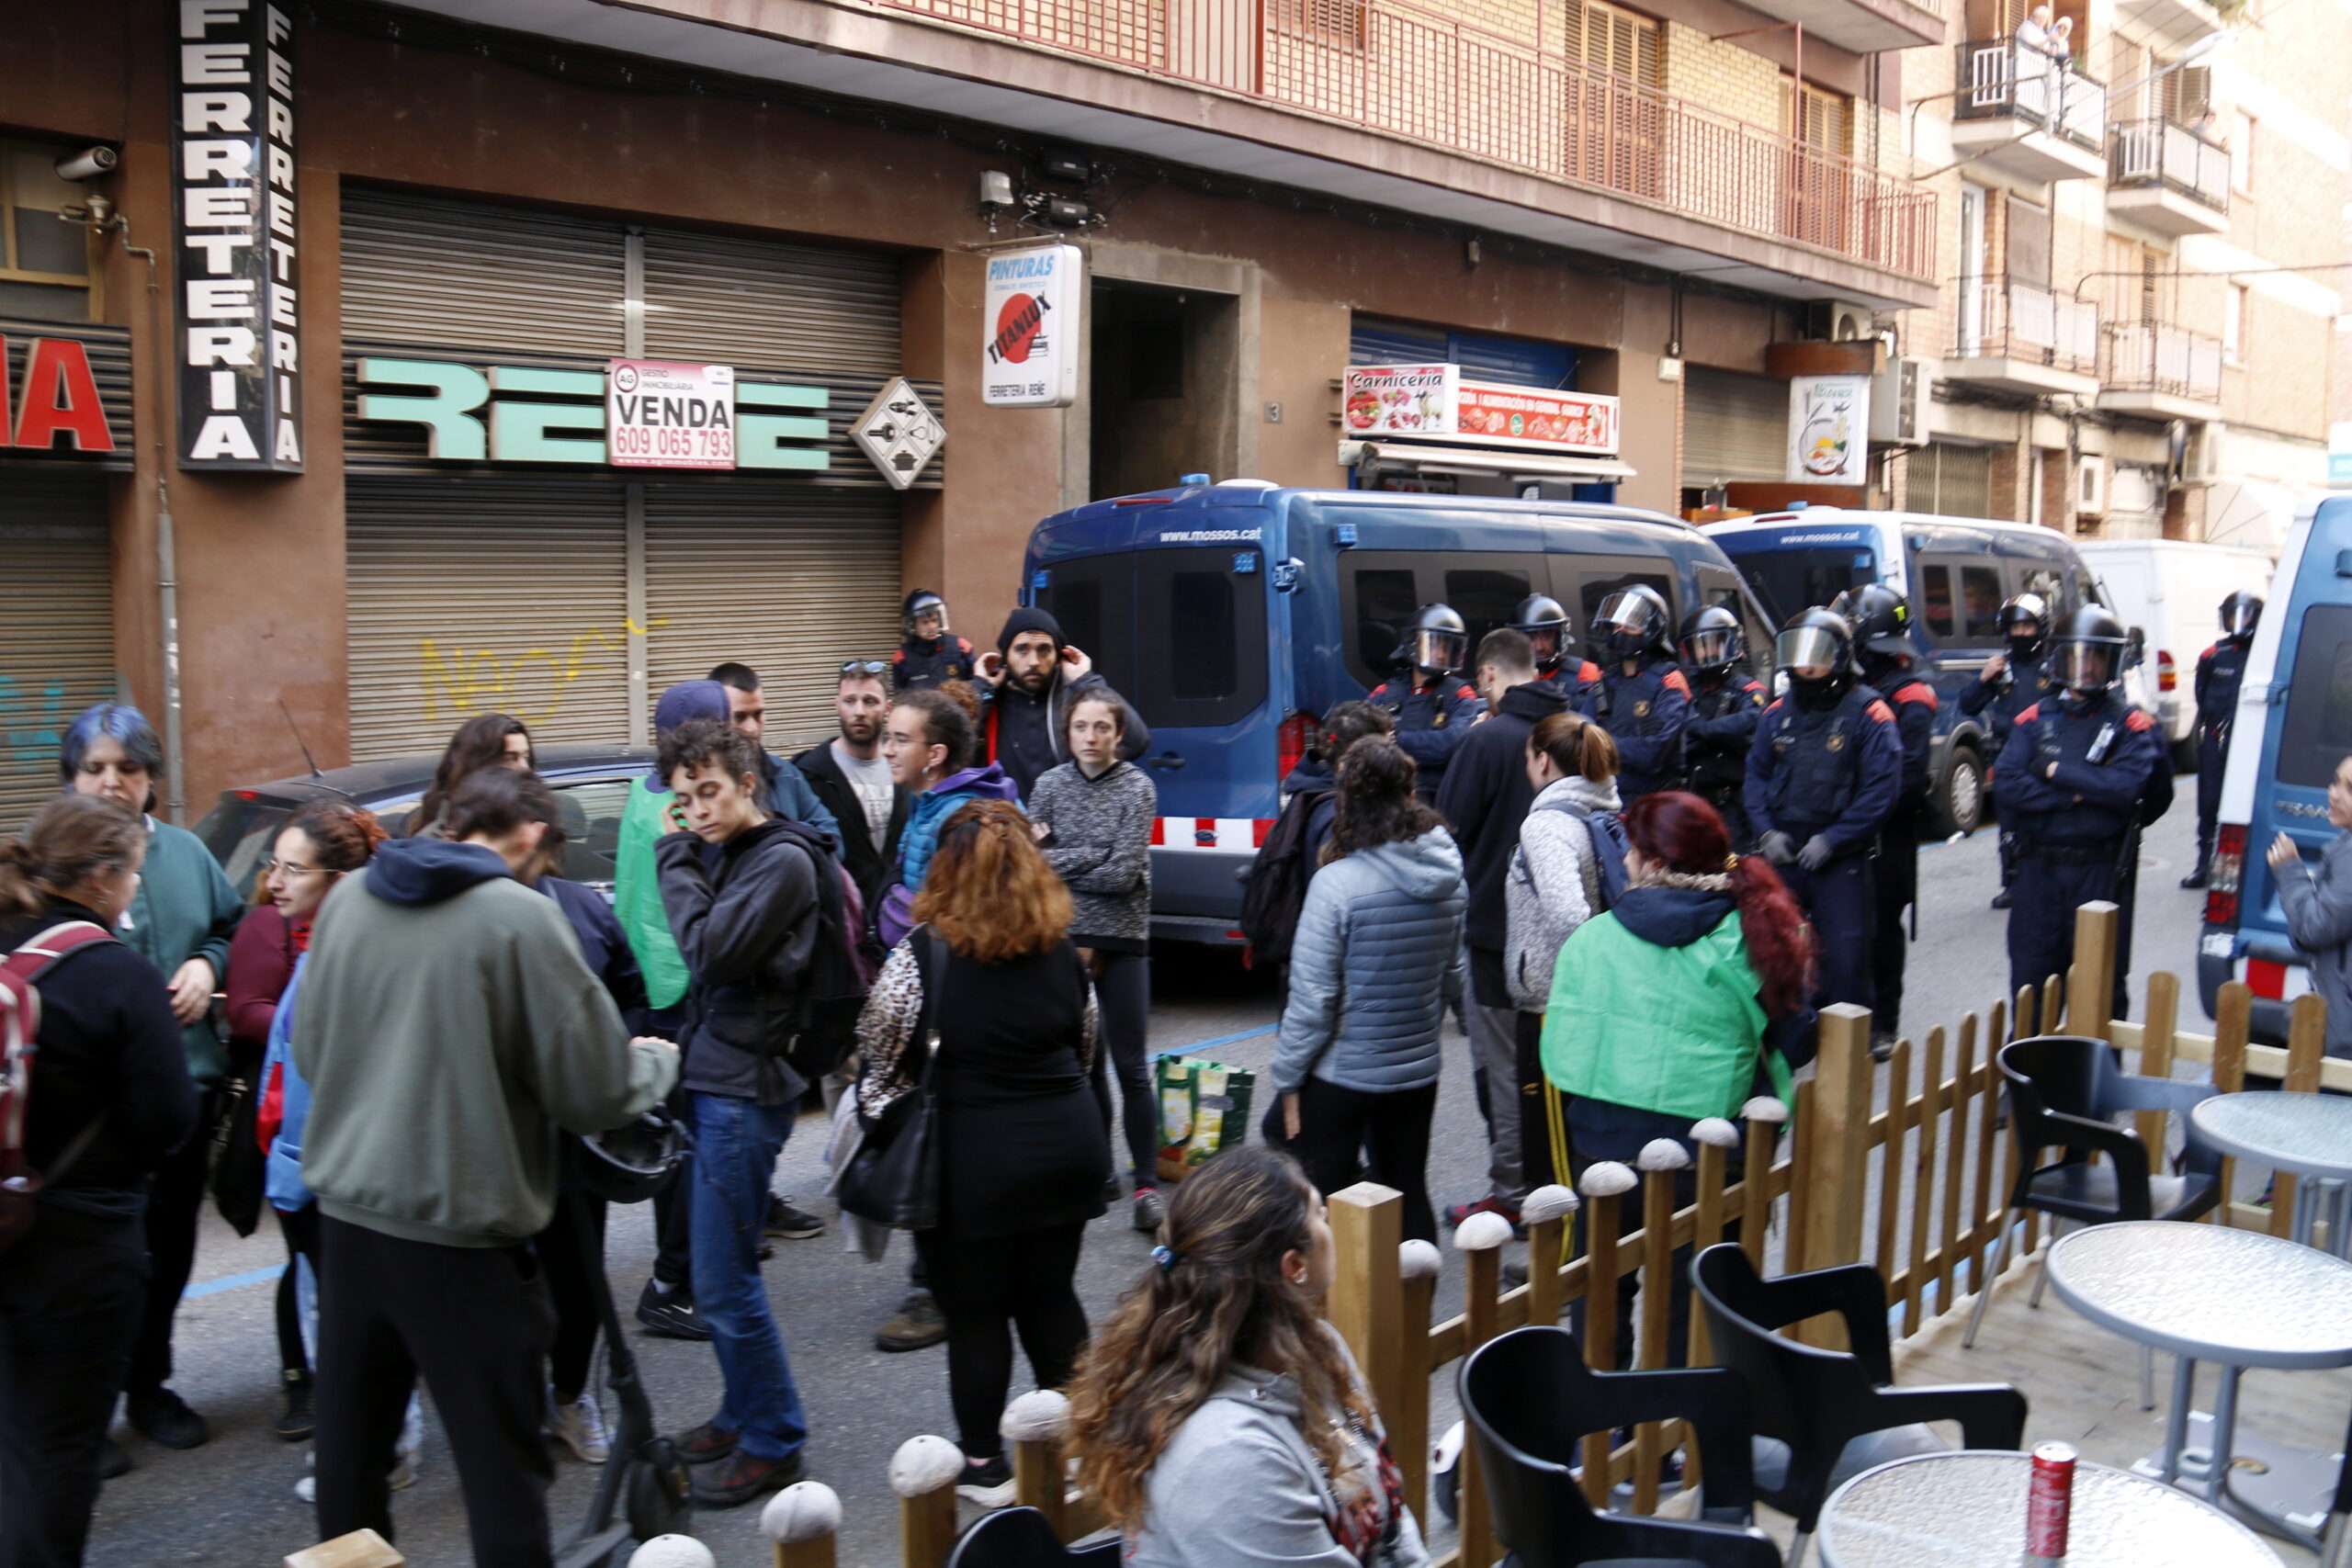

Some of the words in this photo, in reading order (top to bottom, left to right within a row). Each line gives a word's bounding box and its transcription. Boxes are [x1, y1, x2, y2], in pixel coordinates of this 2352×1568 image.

[180, 0, 260, 459] FERRETERIA
[266, 3, 300, 463] FERRETERIA
[988, 254, 1055, 281] PINTURAS
[987, 290, 1052, 365] TITANLUX
[0, 333, 116, 451] A
[358, 357, 830, 470] REE
[616, 394, 730, 429] VENDA
[616, 426, 650, 455] 609
[658, 427, 692, 456] 065
[698, 429, 732, 457] 793
[1159, 526, 1263, 543] www.mossos.cat
